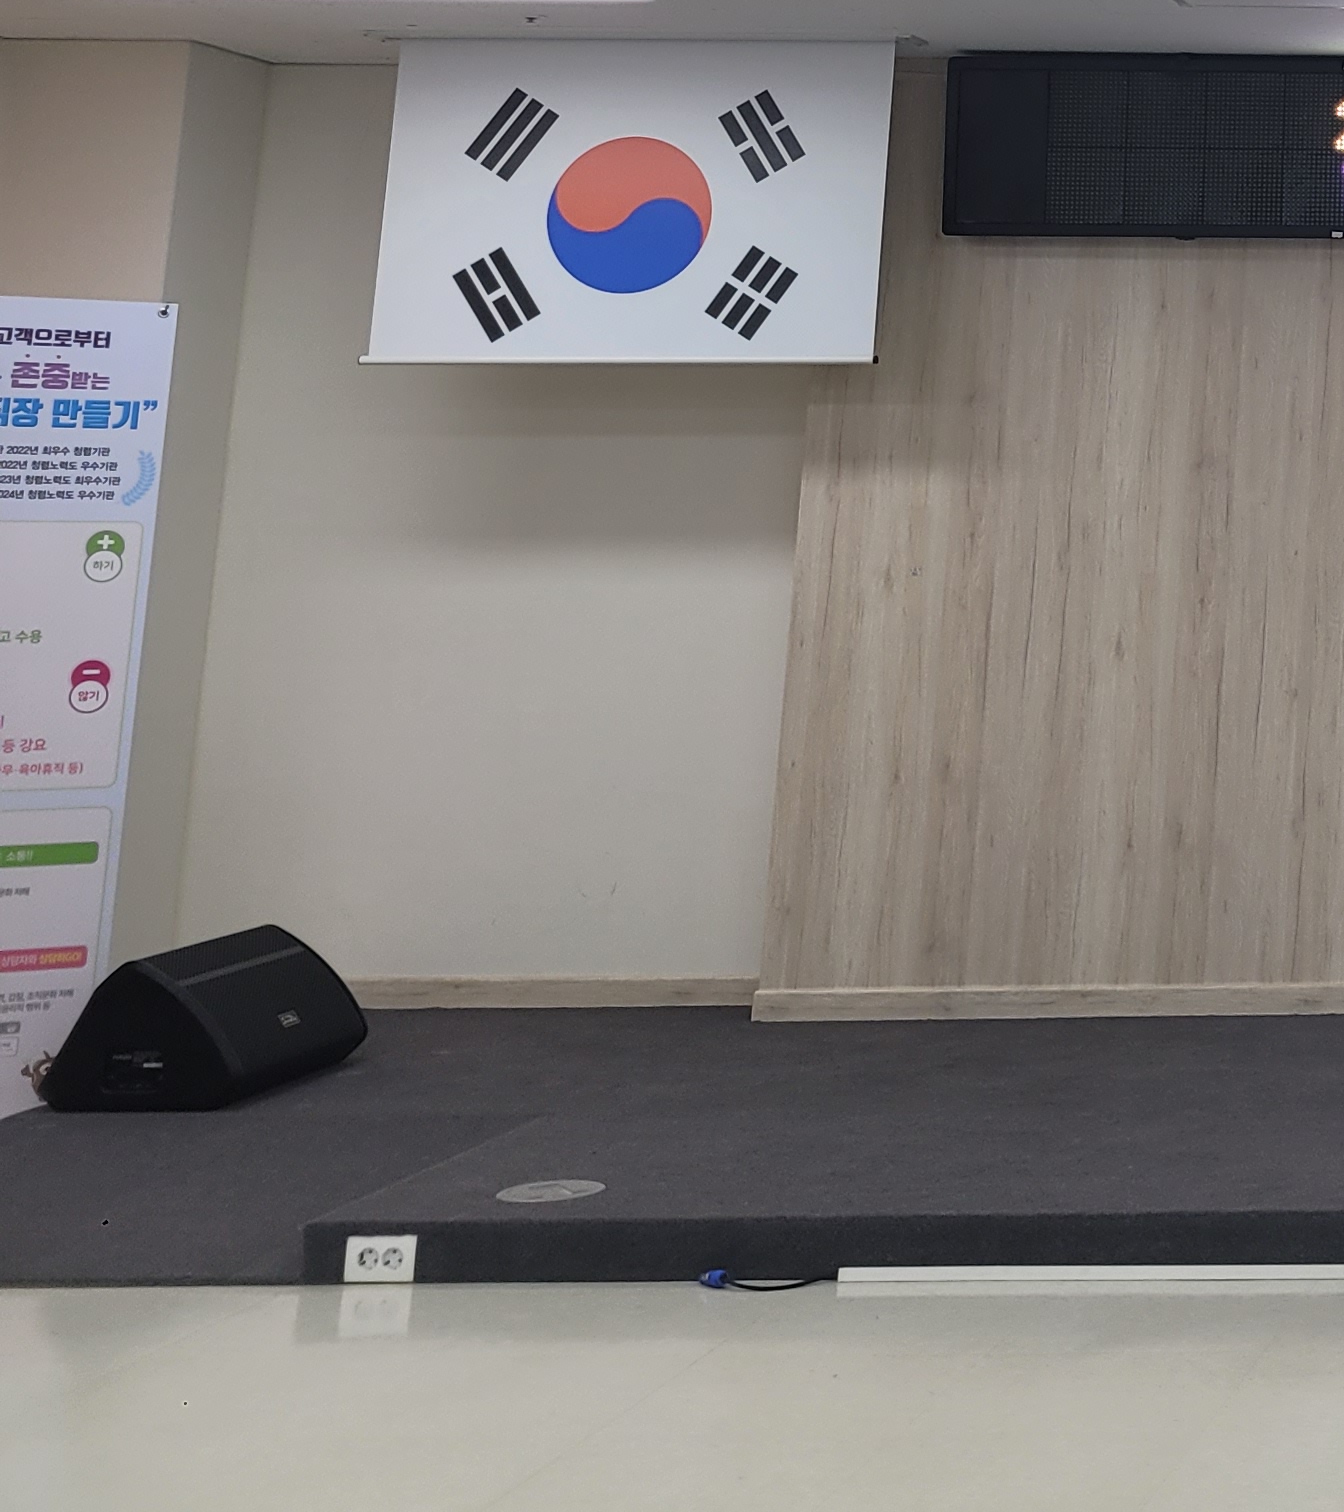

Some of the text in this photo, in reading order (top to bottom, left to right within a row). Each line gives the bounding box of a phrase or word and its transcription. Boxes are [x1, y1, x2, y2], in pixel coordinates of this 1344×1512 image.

[11, 361, 110, 390] 존중받는
[6, 445, 39, 455] 2022년
[92, 560, 115, 571] 하기
[15, 629, 42, 644] 수용
[20, 738, 46, 753] 강요
